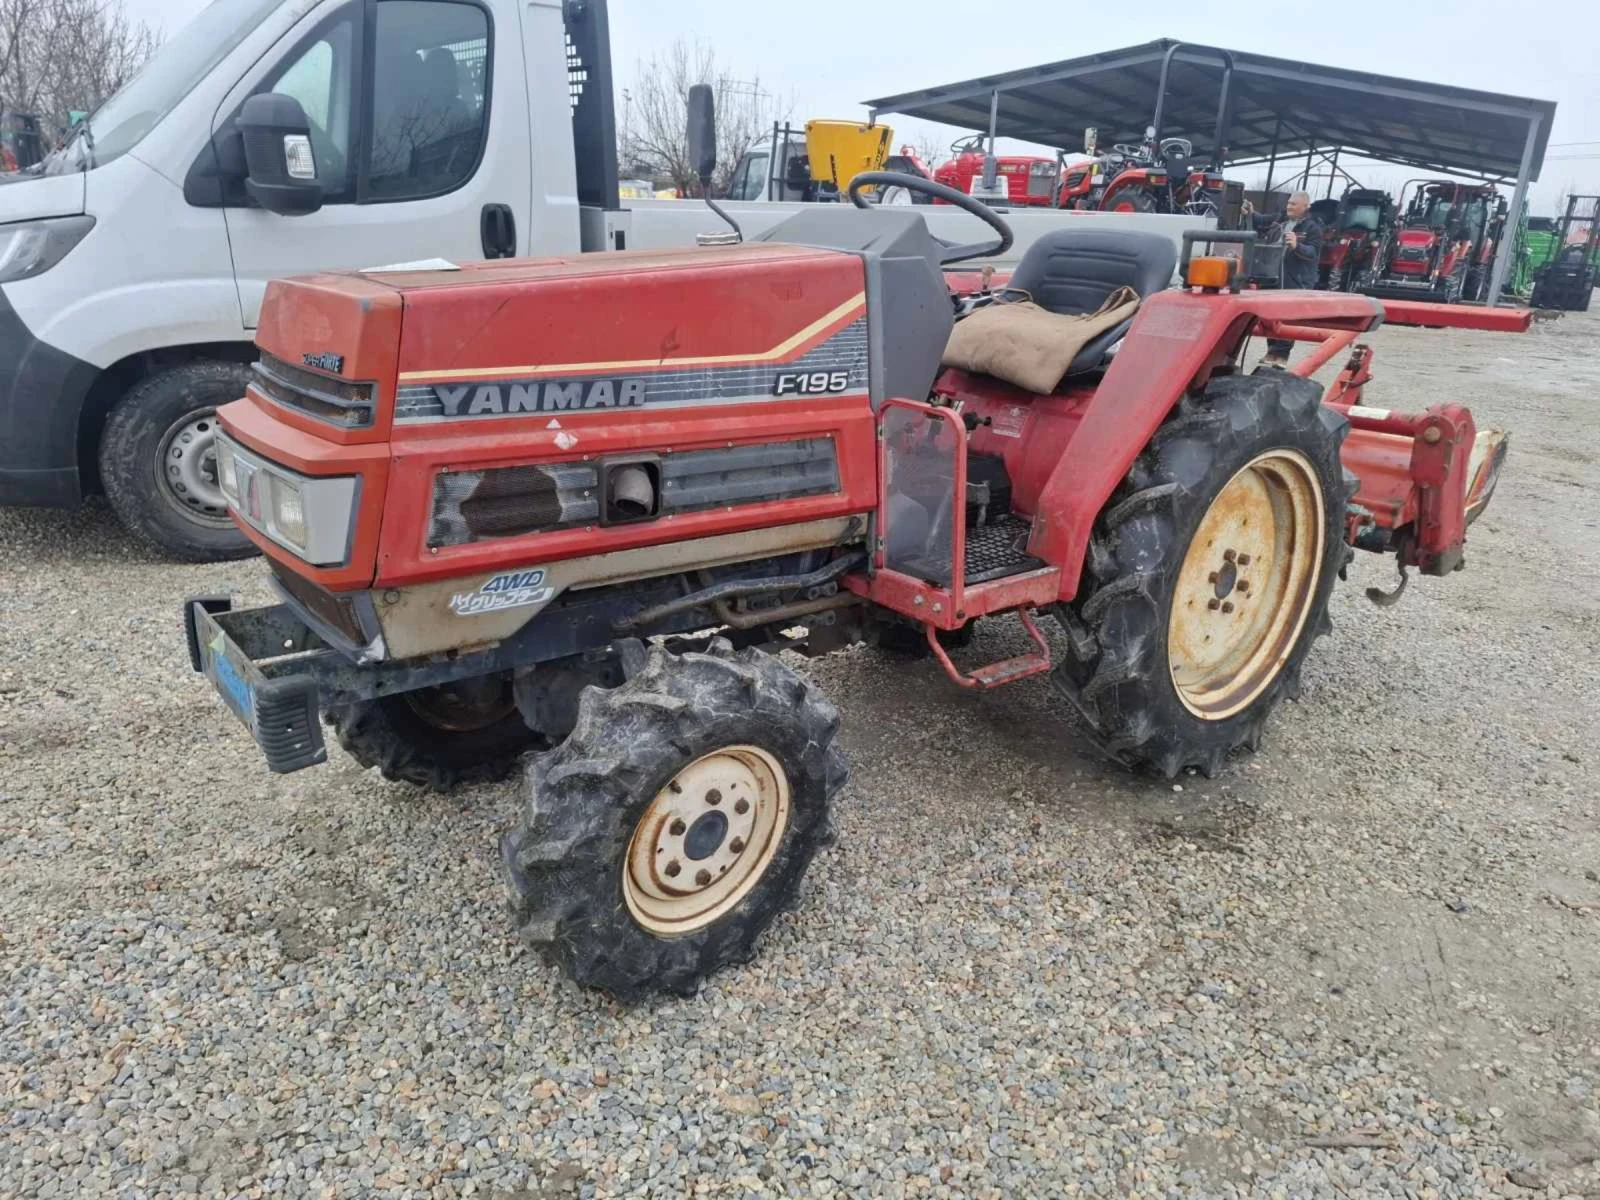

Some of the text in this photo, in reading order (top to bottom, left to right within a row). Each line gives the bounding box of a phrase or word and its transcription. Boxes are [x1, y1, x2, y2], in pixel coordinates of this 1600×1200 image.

[777, 371, 849, 393] F195
[433, 379, 646, 416] YANMAR
[481, 570, 545, 592] 4WD
